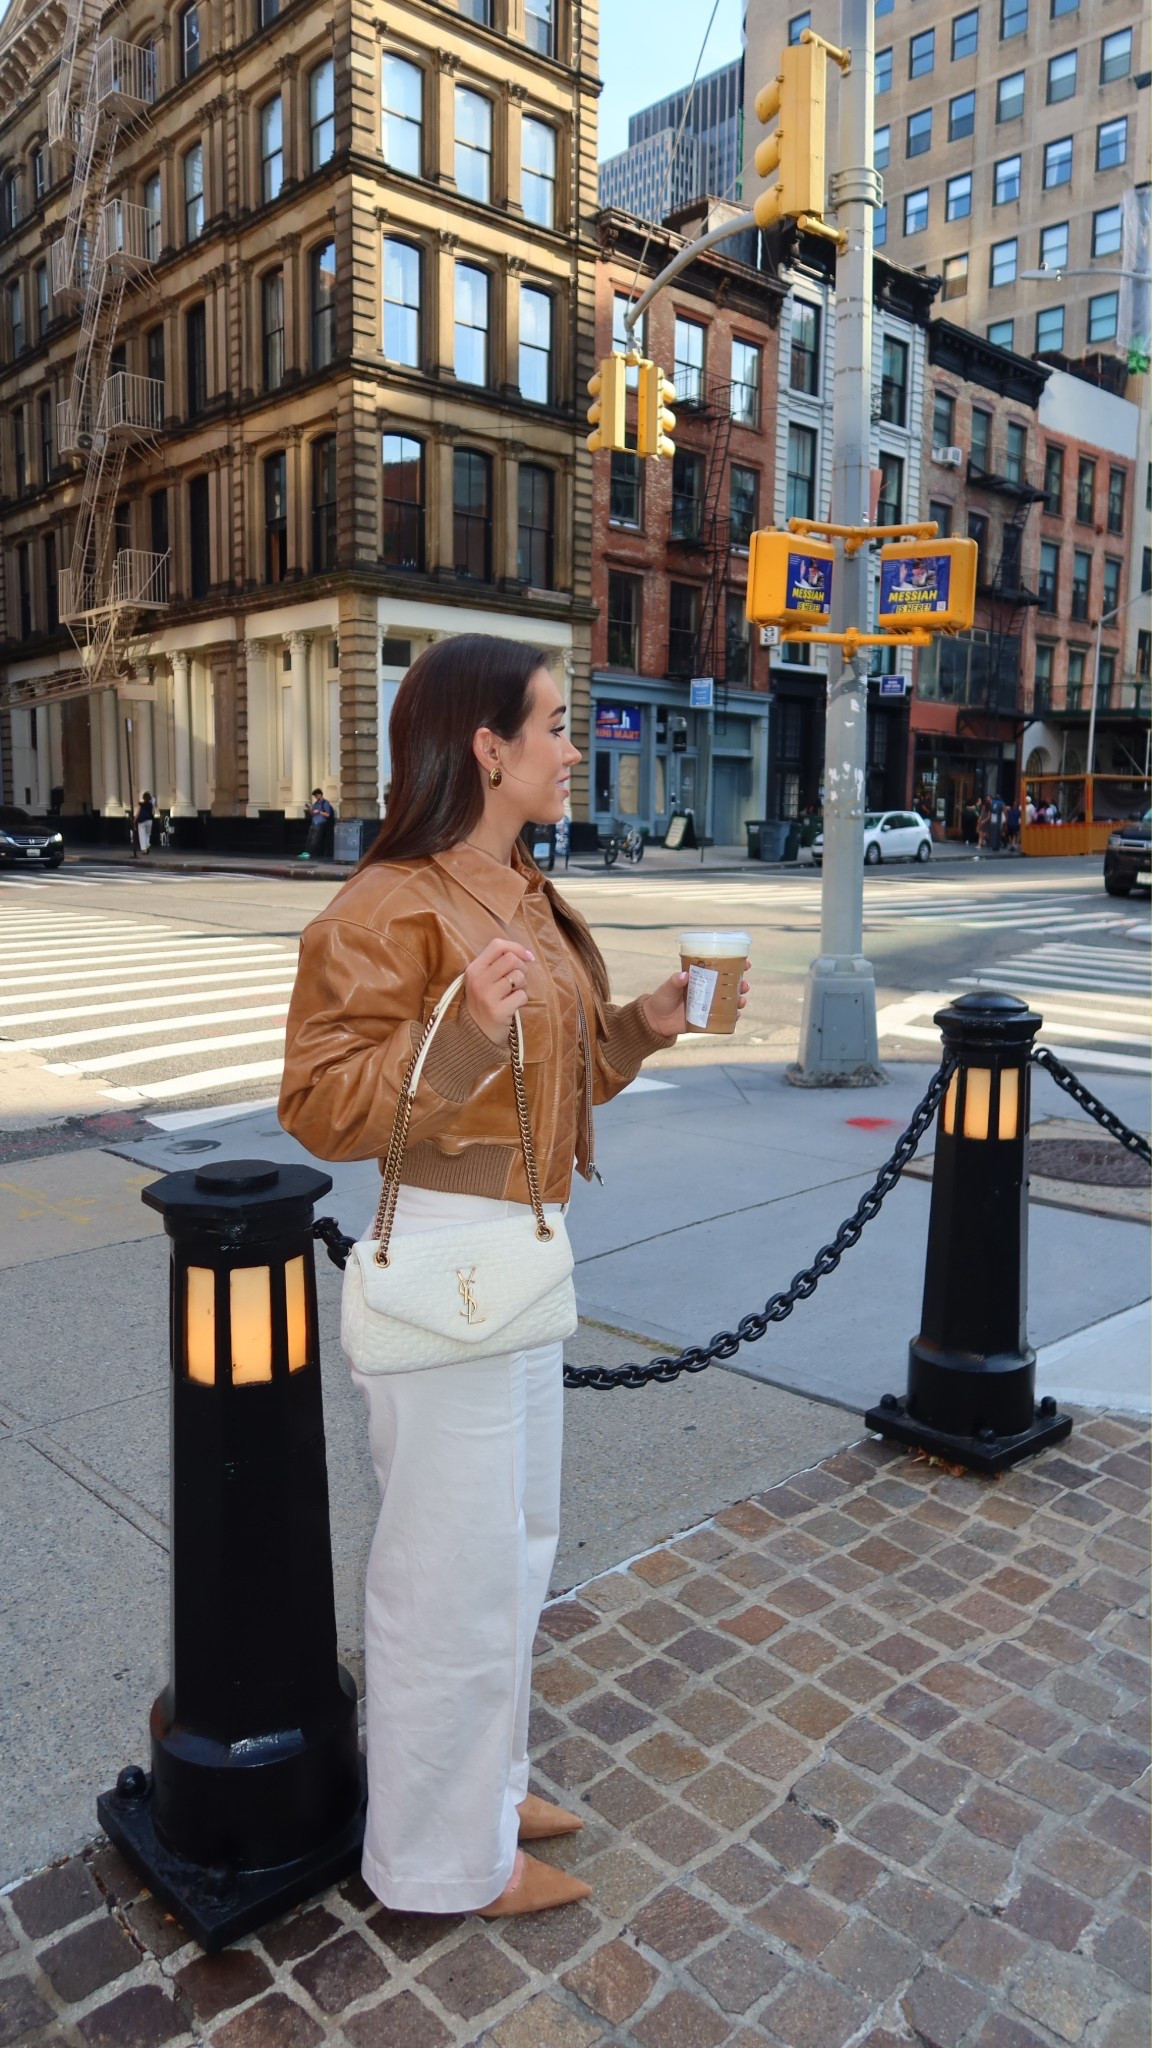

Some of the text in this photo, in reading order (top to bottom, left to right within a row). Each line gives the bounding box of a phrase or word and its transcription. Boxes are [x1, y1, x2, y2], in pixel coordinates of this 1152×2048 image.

[792, 588, 824, 601] MESSIAH
[888, 590, 938, 602] MESSIAH
[896, 603, 931, 613] IS HERE!
[614, 730, 639, 739] MART
